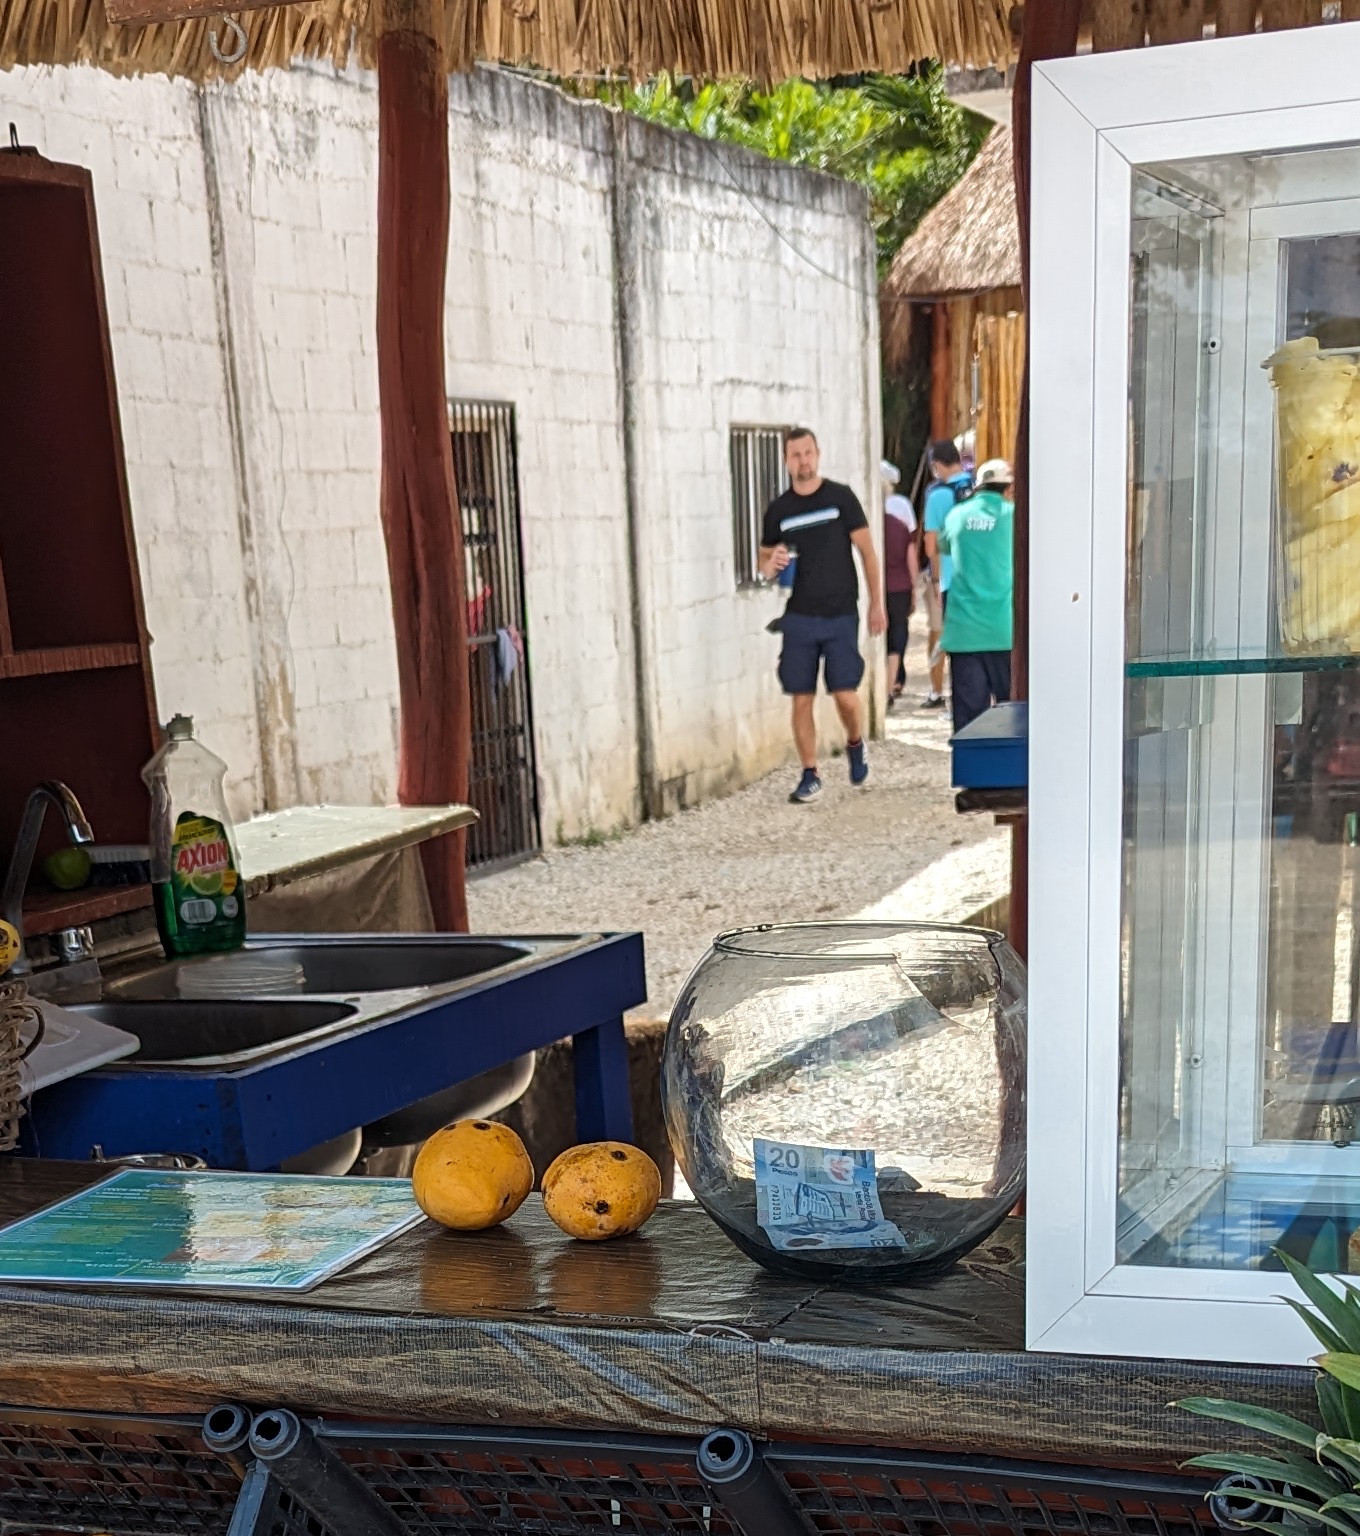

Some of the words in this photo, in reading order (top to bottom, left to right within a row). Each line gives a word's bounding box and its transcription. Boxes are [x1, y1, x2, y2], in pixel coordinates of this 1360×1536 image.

[966, 517, 996, 531] STAFF
[176, 841, 228, 875] AXION
[769, 1147, 800, 1168] 20
